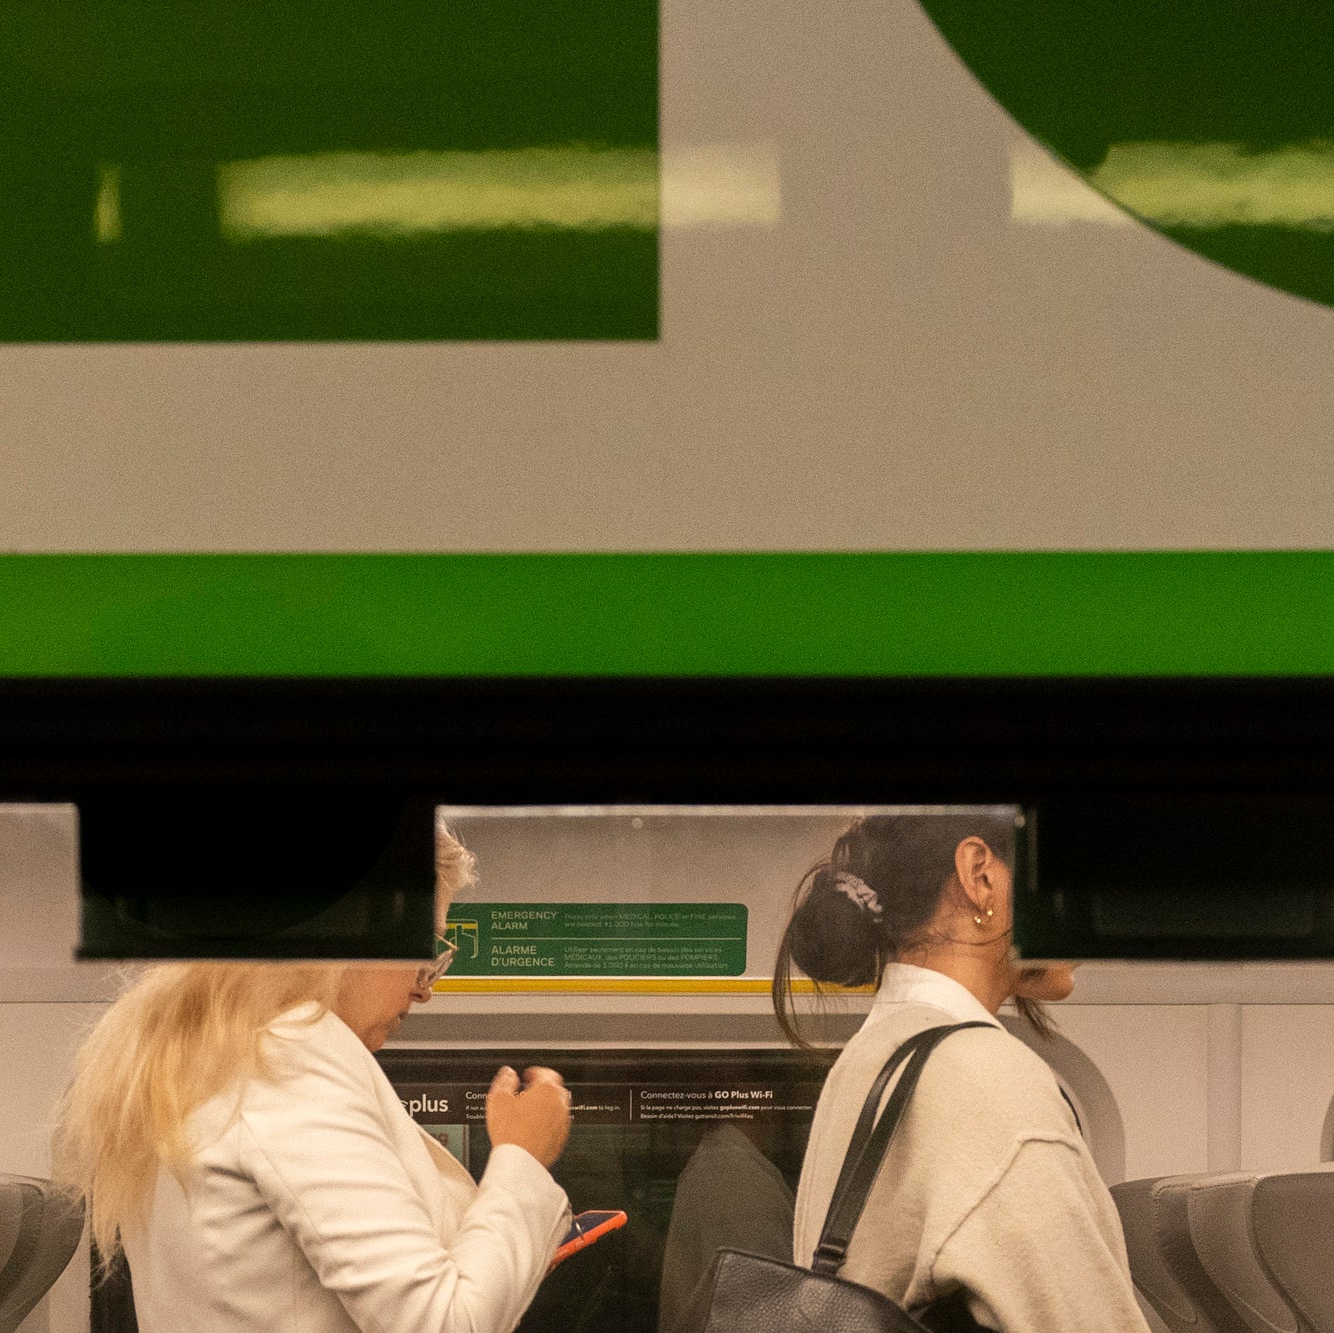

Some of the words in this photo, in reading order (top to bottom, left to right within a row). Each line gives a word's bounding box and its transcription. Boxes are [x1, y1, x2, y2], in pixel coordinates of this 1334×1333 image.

[490, 911, 557, 920] EMERGENCY
[490, 921, 528, 930] ALARM
[490, 945, 537, 955] ALARME
[490, 957, 555, 967] D'URGENCE
[465, 1091, 488, 1100] Conn
[640, 1090, 706, 1099] Connectez-vous
[707, 1090, 713, 1099] à
[714, 1090, 729, 1099] GO
[730, 1090, 749, 1099] Plus
[749, 1090, 773, 1099] Wi-Fi
